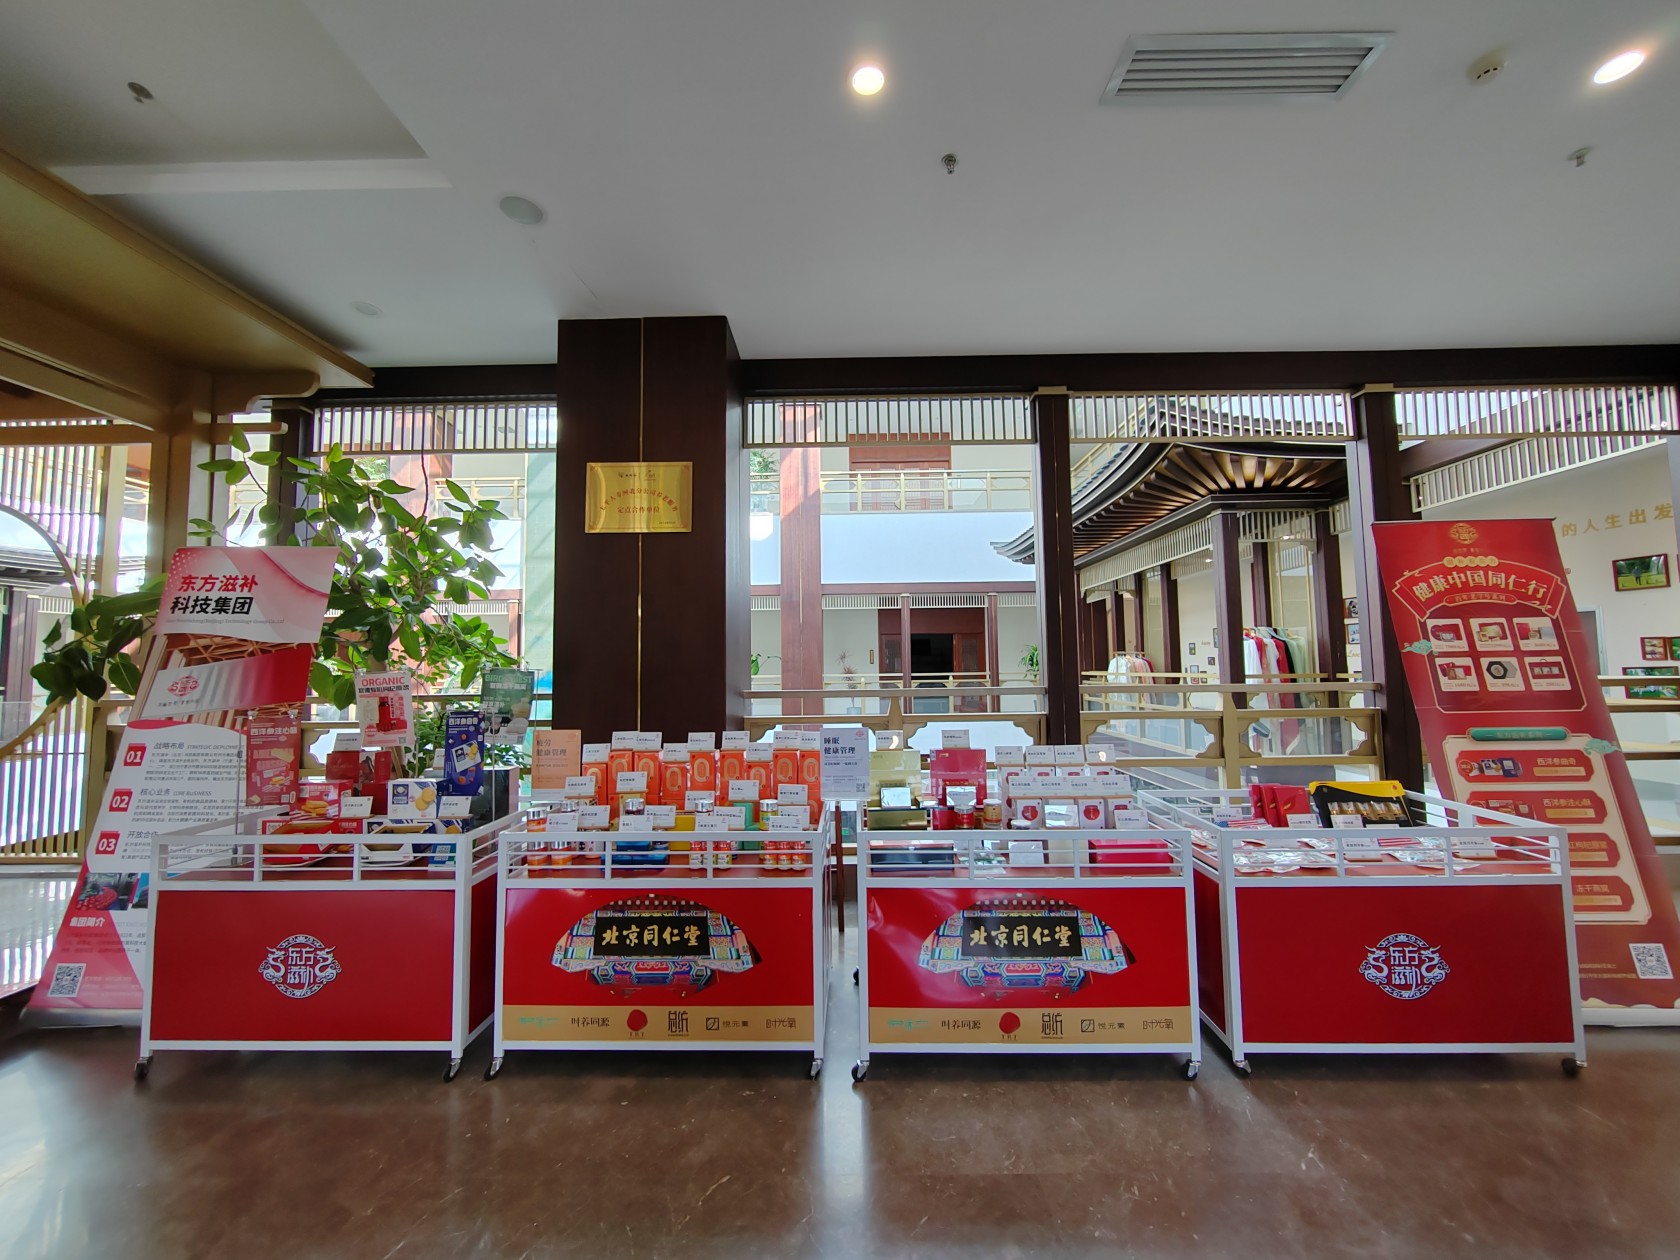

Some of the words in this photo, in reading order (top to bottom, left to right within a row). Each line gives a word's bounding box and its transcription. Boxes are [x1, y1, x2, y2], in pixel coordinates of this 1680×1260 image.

[1562, 503, 1674, 537] 的人生出发
[177, 574, 259, 593] 东方滋补
[1411, 569, 1548, 602] 健康中国同仁行
[170, 595, 254, 615] 科技集团
[362, 676, 405, 687] ORGANIC
[153, 742, 185, 750] 战略布局
[824, 736, 840, 745] 睡眠
[126, 750, 142, 763] 01
[536, 748, 567, 756] 健康管理
[824, 746, 856, 755] 健康管理
[140, 788, 171, 796] 核心业务
[112, 795, 129, 808] 02
[98, 838, 116, 851] 03
[69, 916, 105, 927] 集团简介
[602, 924, 700, 947] 北京同仁堂
[970, 924, 1072, 947] 北京同仁堂
